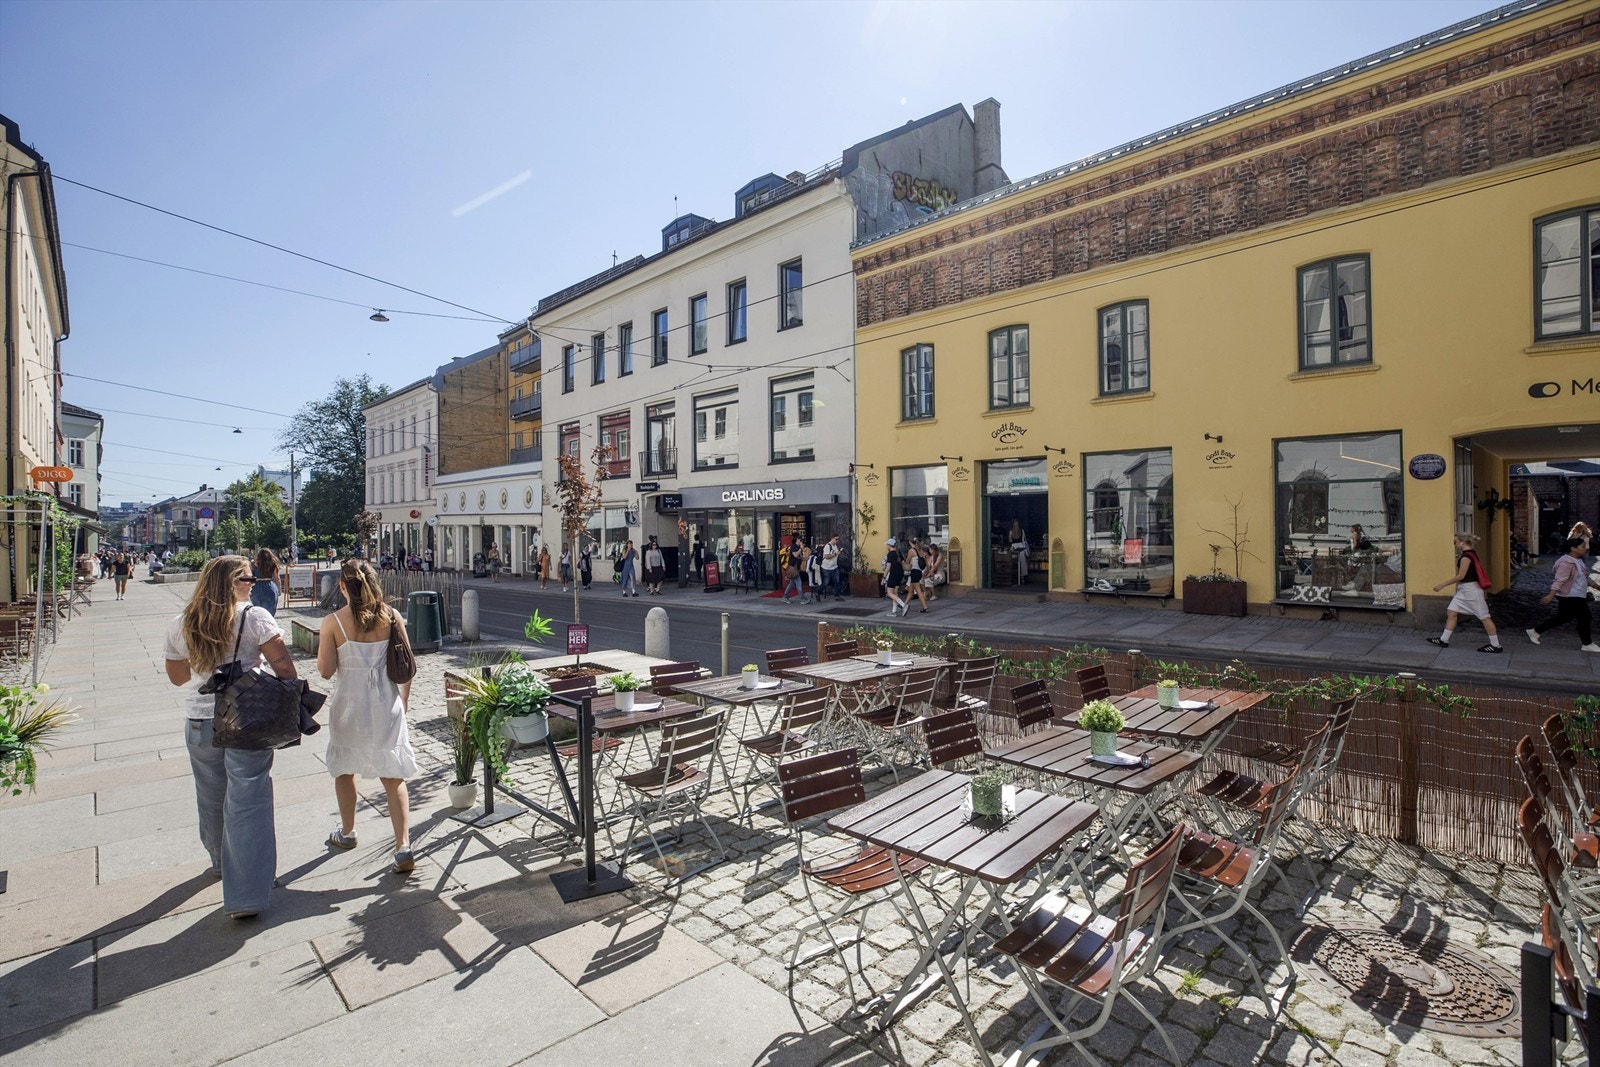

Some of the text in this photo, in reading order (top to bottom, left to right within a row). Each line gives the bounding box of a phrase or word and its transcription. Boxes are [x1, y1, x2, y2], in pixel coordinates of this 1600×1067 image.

[991, 423, 1008, 439] Godt
[37, 470, 67, 479] DIGG
[721, 488, 784, 502] CARLINGS
[568, 636, 587, 644] HER
